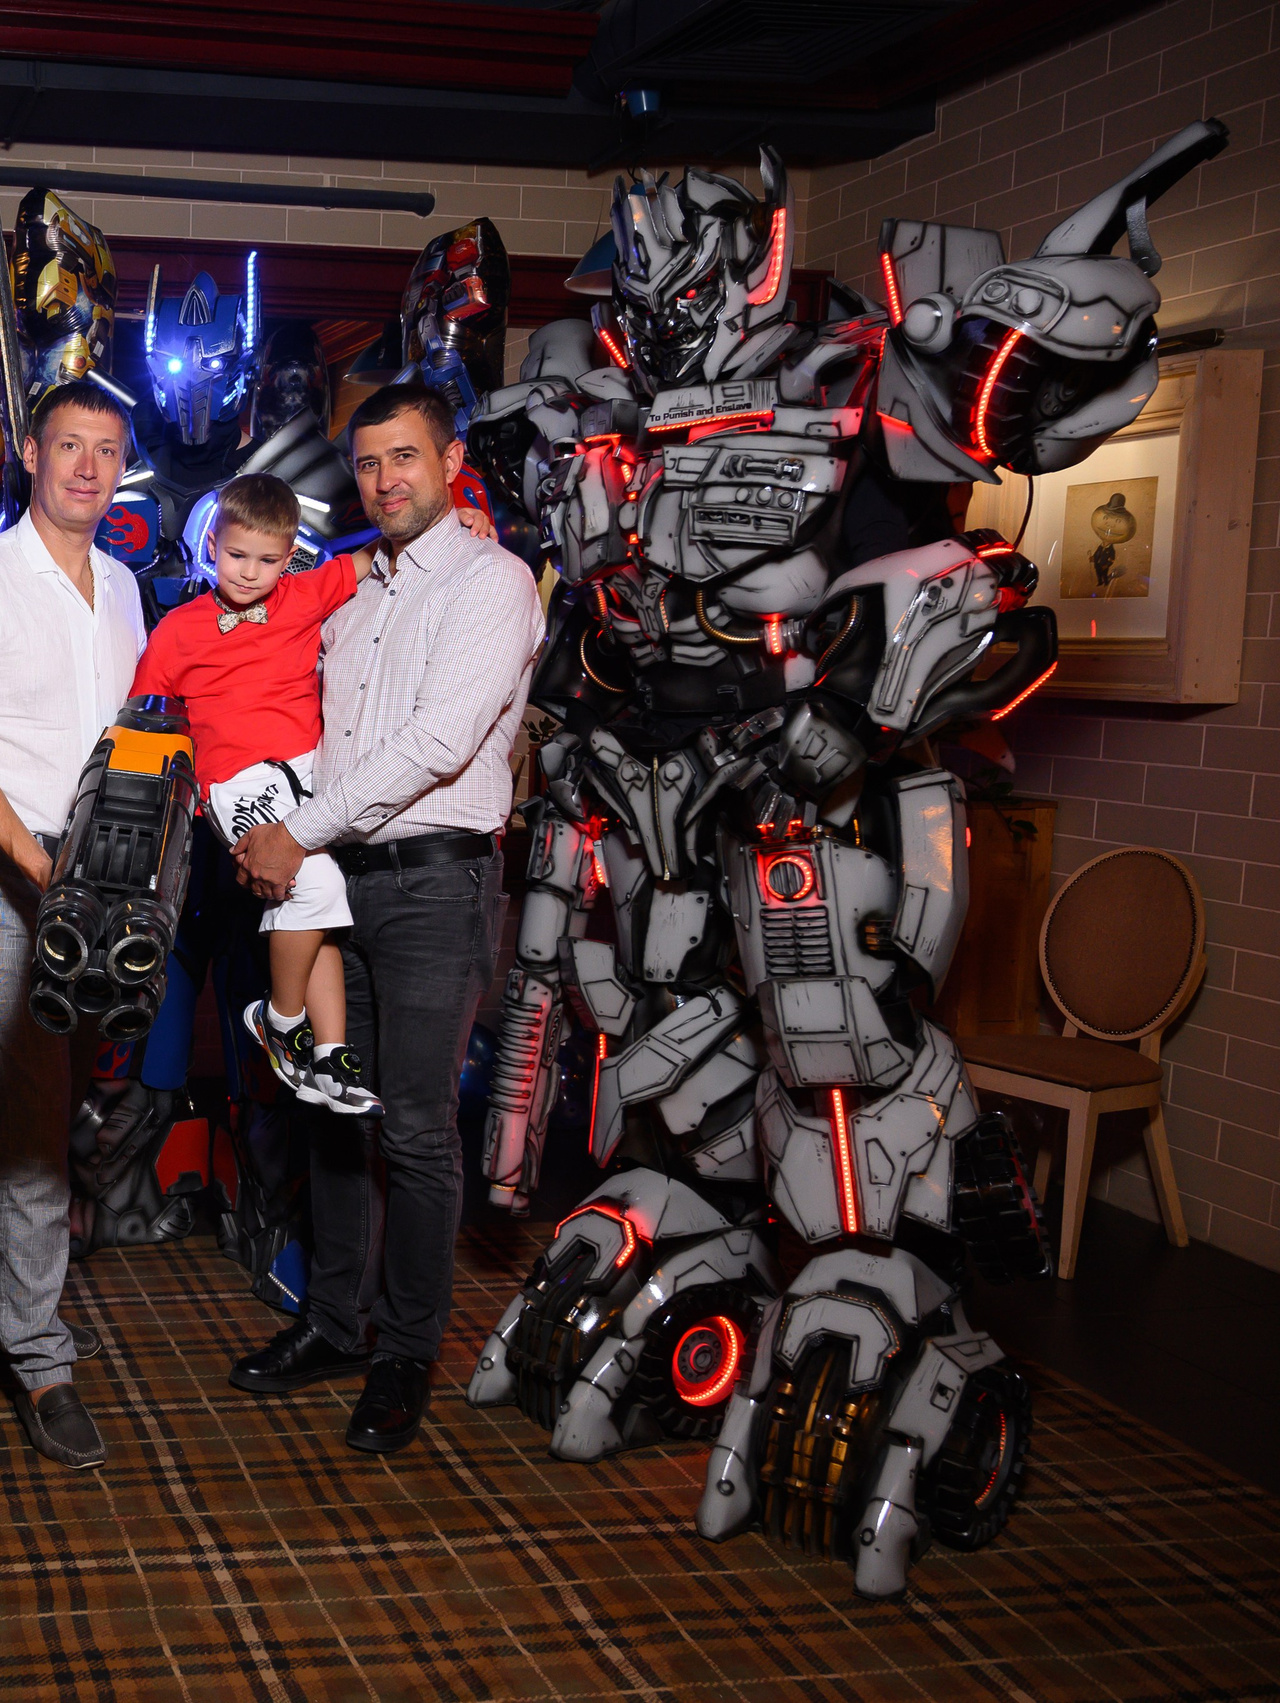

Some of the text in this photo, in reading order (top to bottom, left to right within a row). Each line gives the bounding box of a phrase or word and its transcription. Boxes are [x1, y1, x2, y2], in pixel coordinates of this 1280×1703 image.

[650, 402, 752, 422] To Punish and Enslave
